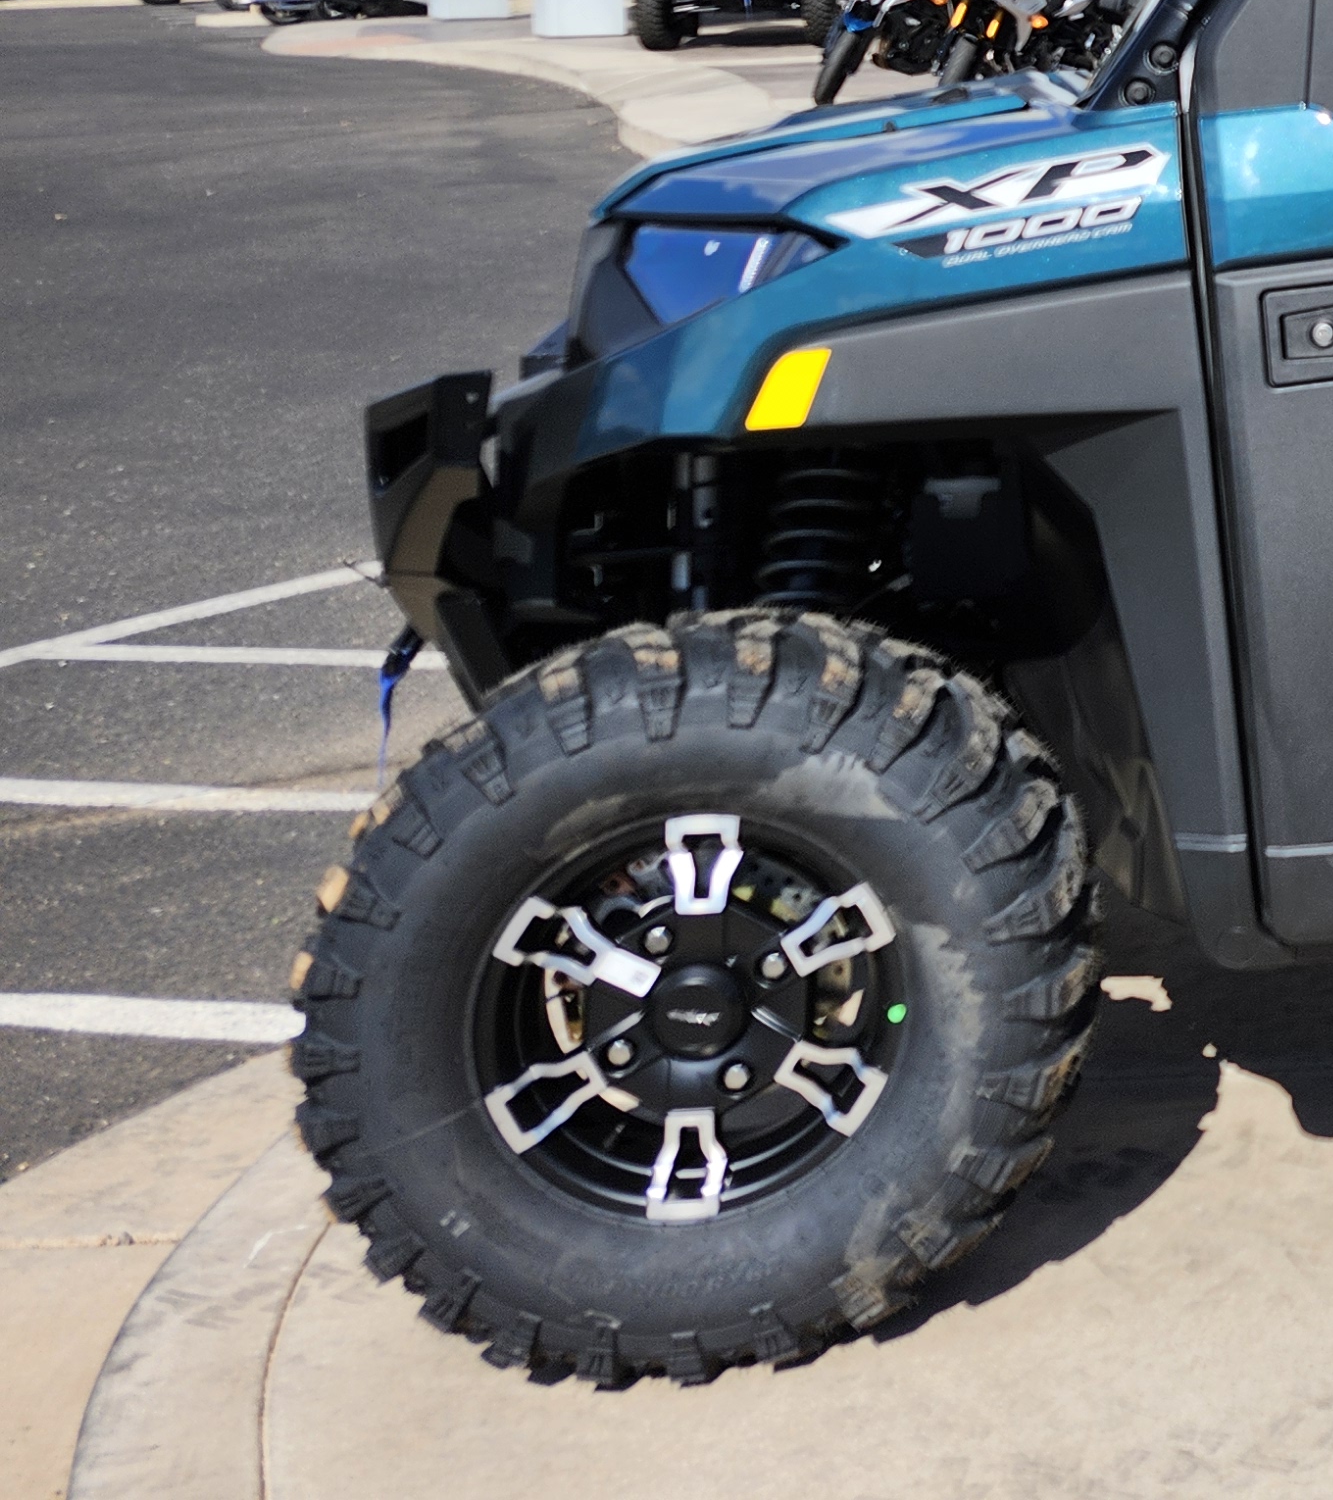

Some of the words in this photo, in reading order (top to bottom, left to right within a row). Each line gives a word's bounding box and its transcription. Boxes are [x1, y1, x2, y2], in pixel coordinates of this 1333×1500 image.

[884, 148, 1155, 231] XP
[942, 251, 992, 268] DUAL
[994, 229, 1091, 258] OVERHEAD
[943, 196, 1142, 255] 1000
